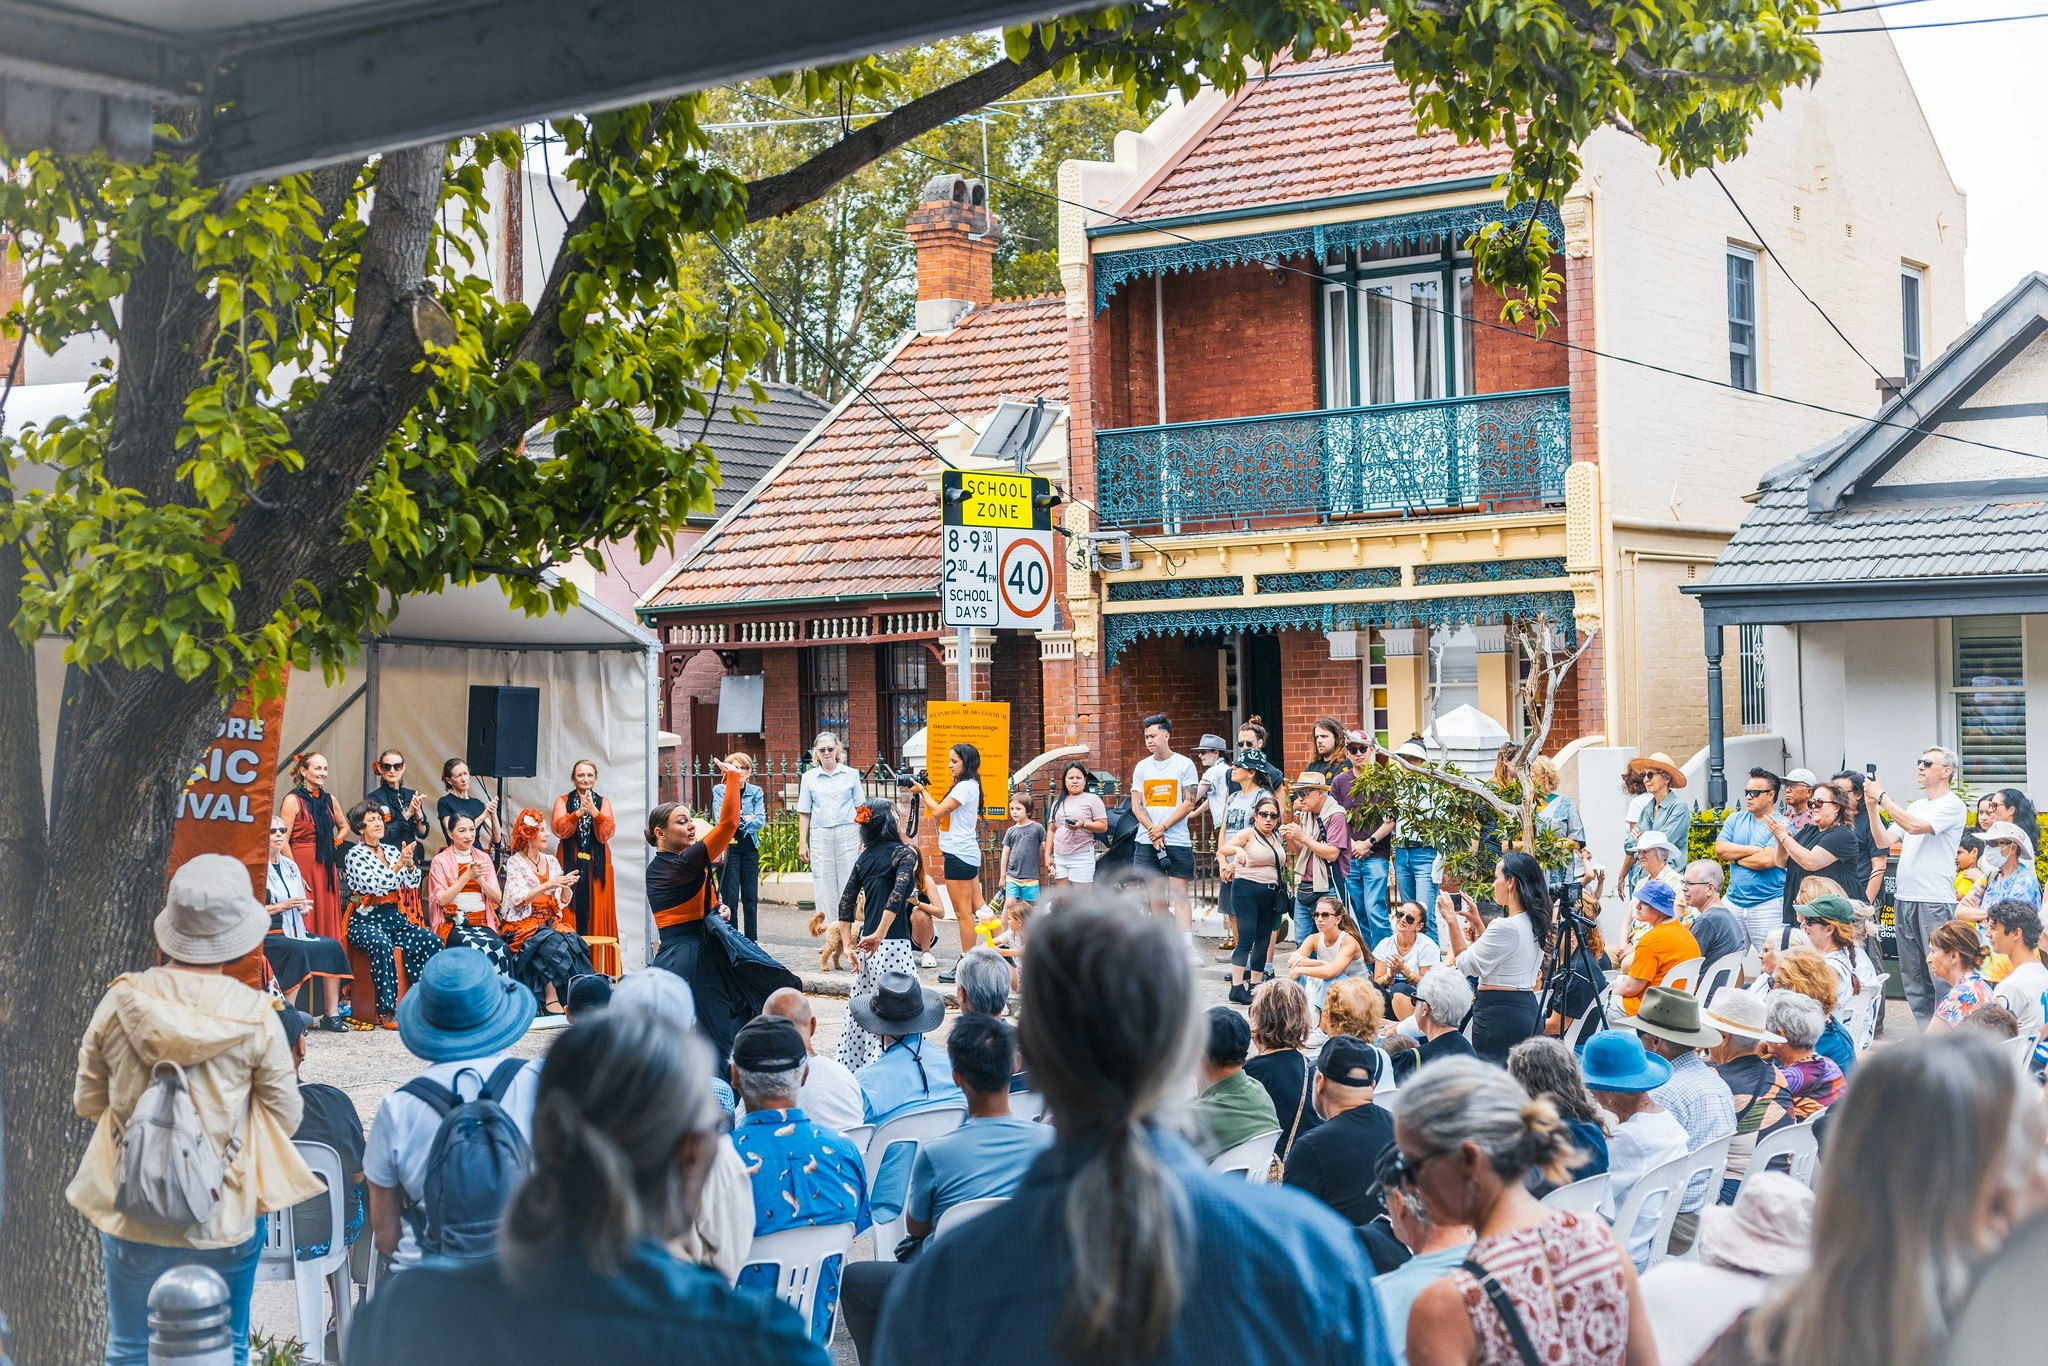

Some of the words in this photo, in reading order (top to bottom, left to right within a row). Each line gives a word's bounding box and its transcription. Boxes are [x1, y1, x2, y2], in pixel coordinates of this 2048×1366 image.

[967, 480, 1027, 499] SCHOOL
[977, 502, 1019, 519] ZONE
[1008, 560, 1044, 596] 40
[949, 589, 993, 602] SCHOOL
[956, 606, 987, 618] DAYS
